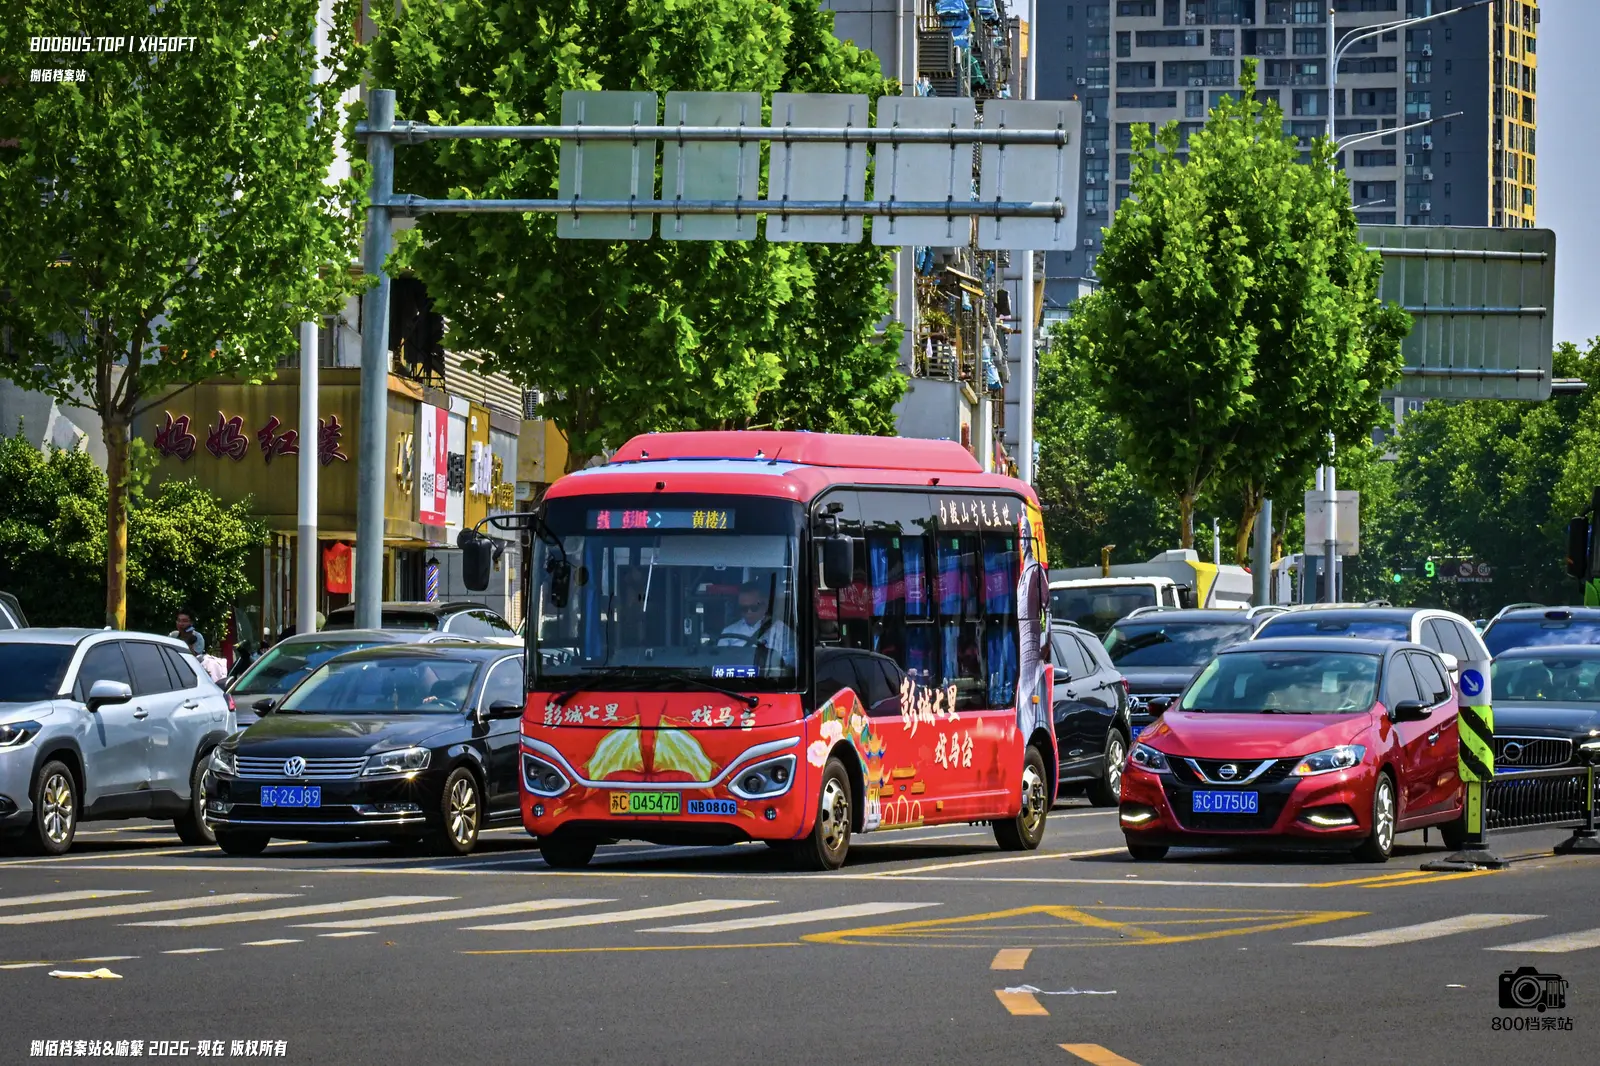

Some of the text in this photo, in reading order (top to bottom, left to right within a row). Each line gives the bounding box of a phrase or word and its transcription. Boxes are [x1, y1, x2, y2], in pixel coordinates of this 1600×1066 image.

[153, 410, 349, 466] 妈妈红装
[1424, 561, 1435, 578] 9
[714, 668, 756, 678] 投币二元
[543, 702, 756, 731] 彭城七里 戏马台
[900, 676, 960, 739] 彭城七里
[934, 730, 974, 769] 戏马台
[690, 801, 736, 813] NB0806
